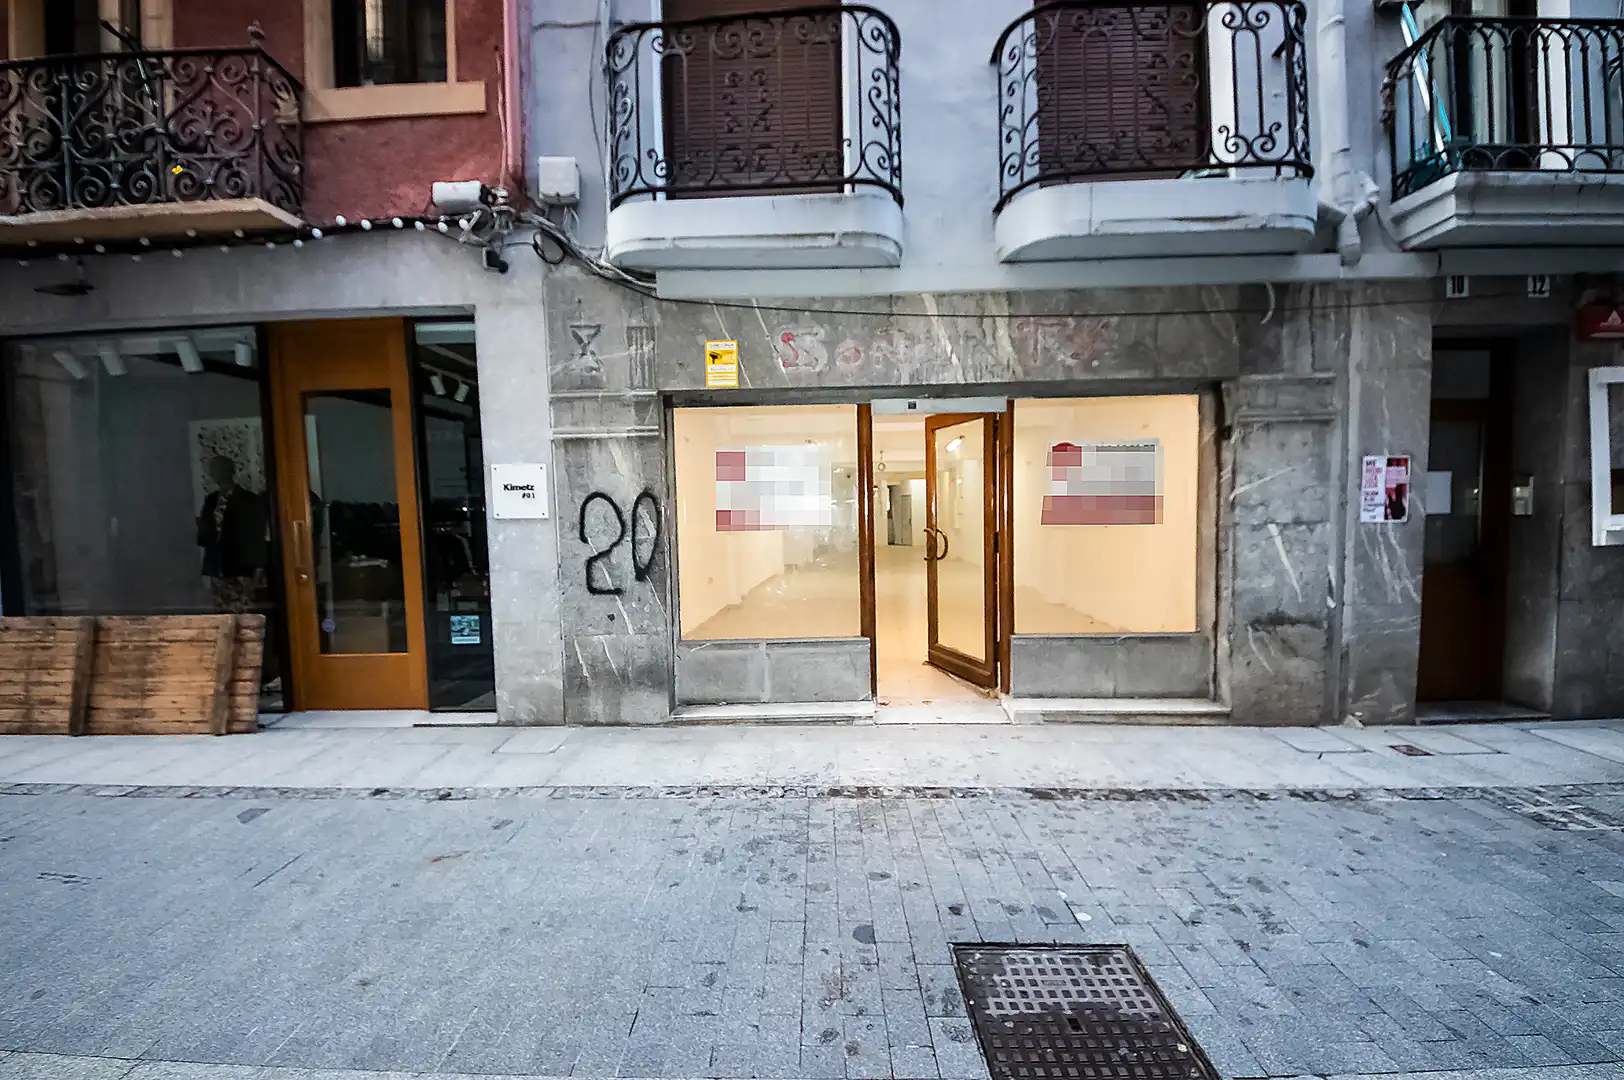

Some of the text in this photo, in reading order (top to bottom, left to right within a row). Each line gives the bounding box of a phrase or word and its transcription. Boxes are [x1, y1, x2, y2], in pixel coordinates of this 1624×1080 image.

[1451, 275, 1465, 294] 10
[1531, 275, 1546, 294] 12
[503, 483, 535, 491] Kimetz
[579, 487, 660, 595] 20
